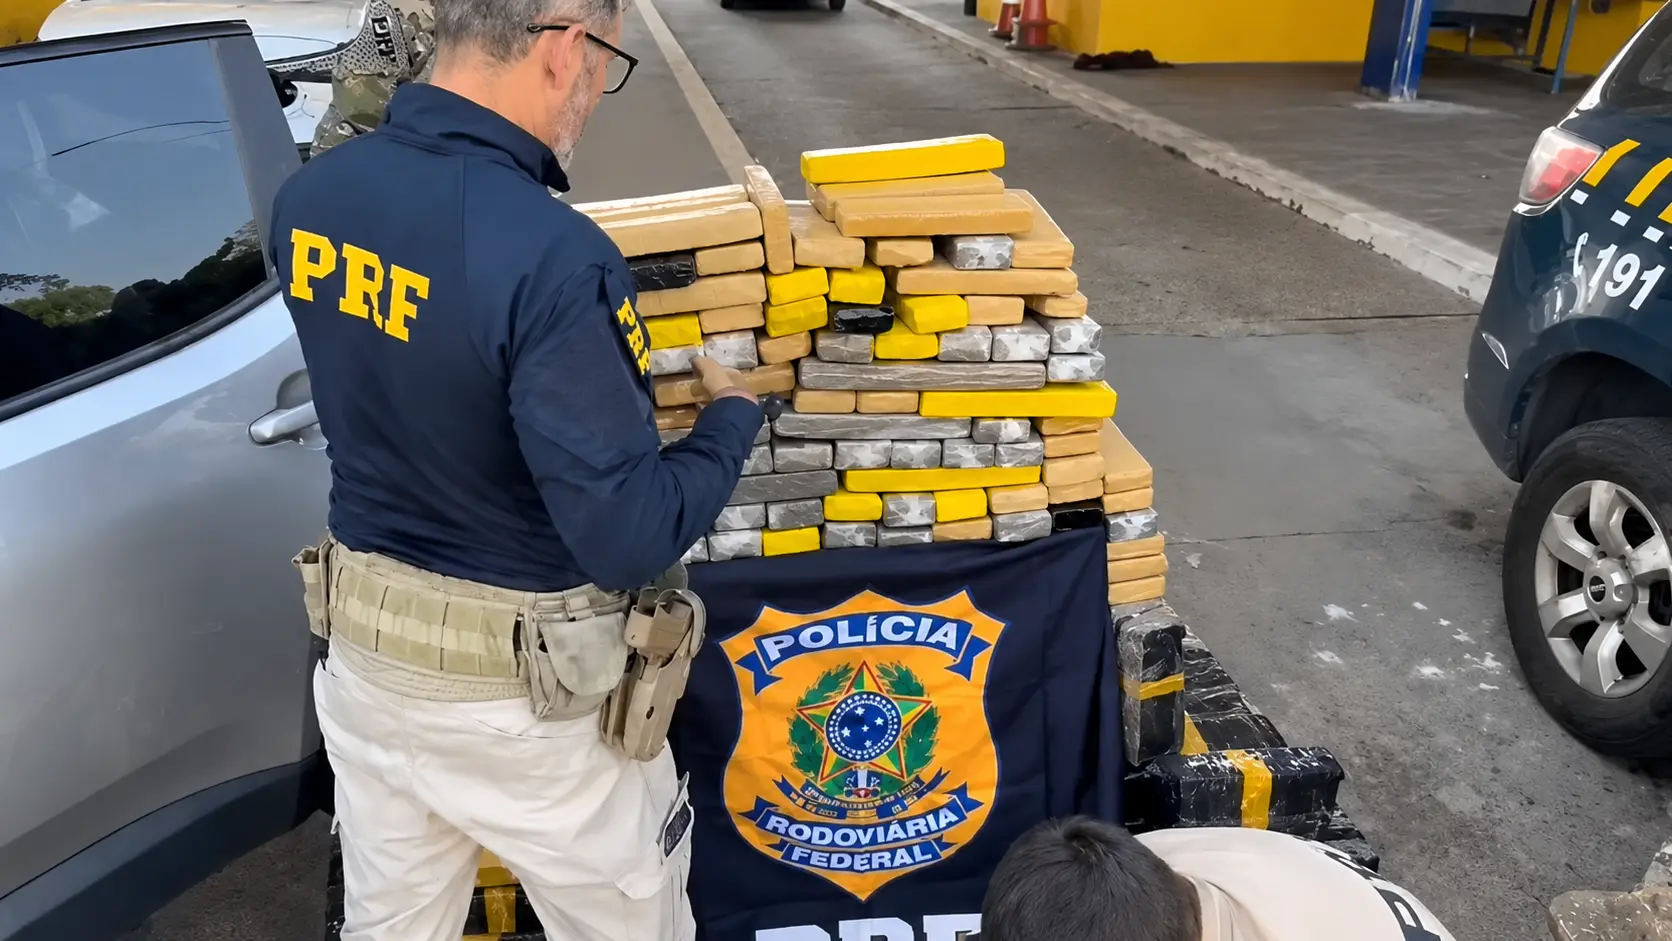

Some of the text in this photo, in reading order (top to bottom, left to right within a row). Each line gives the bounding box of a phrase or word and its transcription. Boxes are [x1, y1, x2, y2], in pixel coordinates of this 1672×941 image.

[290, 228, 430, 342] PRF
[1588, 243, 1666, 310] 191
[761, 615, 958, 662] POLÍCIA
[765, 808, 959, 847] RODOVIÁRIA
[791, 845, 932, 872] FEDERAL
